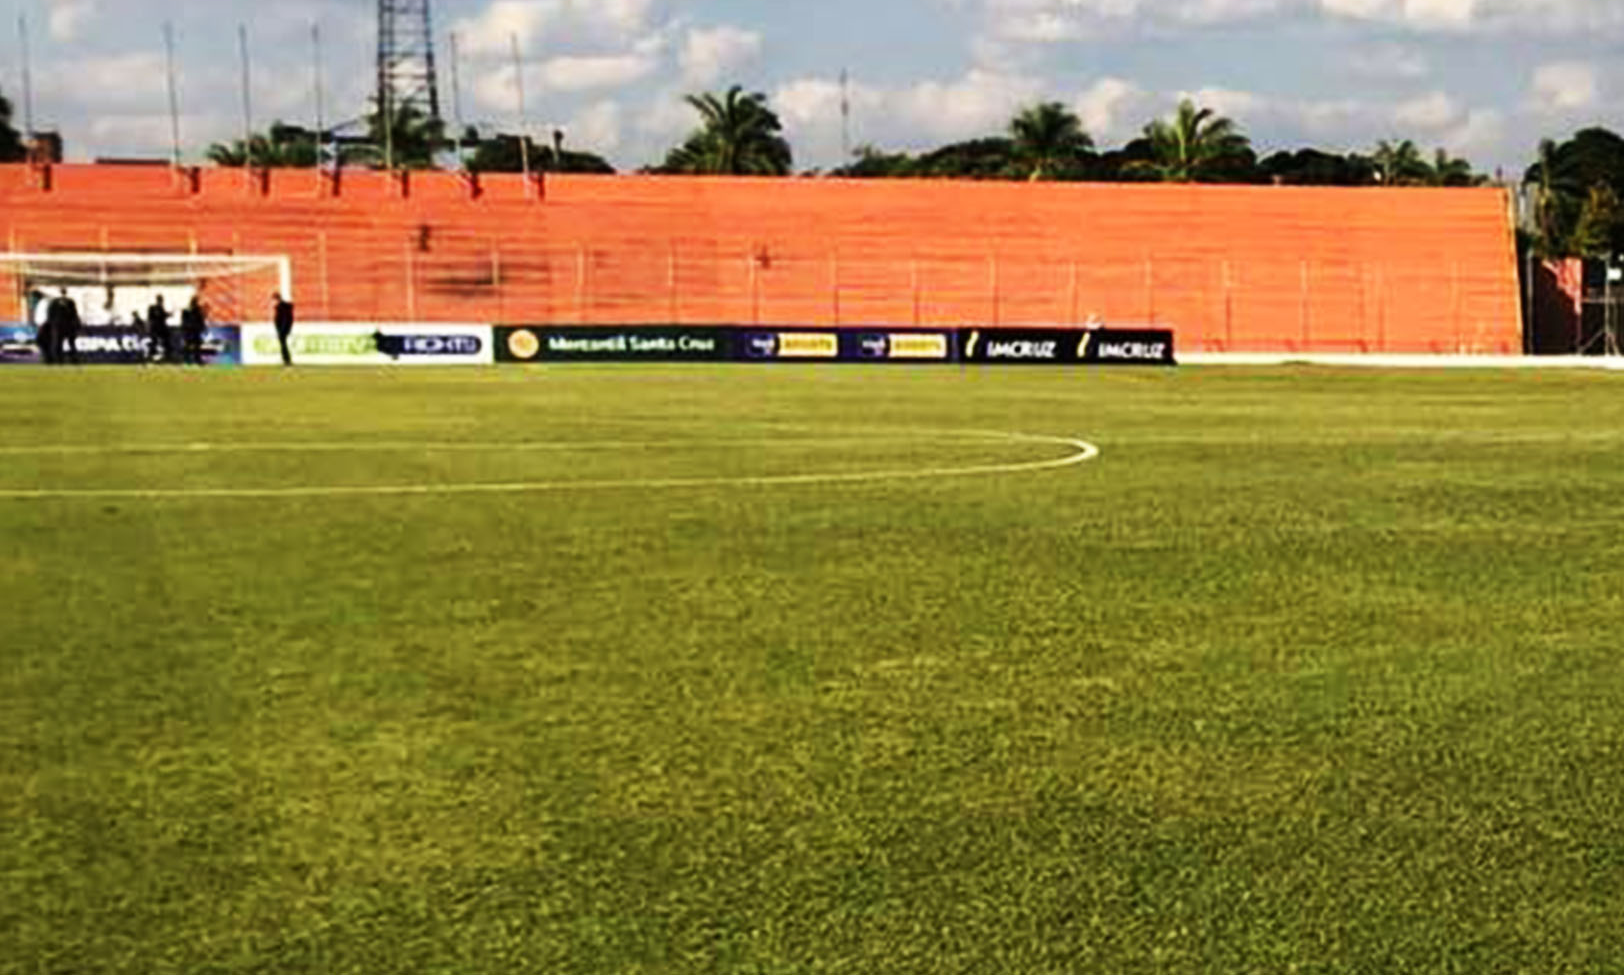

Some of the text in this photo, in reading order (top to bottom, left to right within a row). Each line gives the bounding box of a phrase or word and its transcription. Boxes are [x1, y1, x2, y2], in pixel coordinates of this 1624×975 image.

[629, 335, 675, 351] Santa
[678, 335, 715, 351] Cruz
[986, 339, 1057, 358] IMCRUZ
[1097, 340, 1166, 359] IMCRUZ
